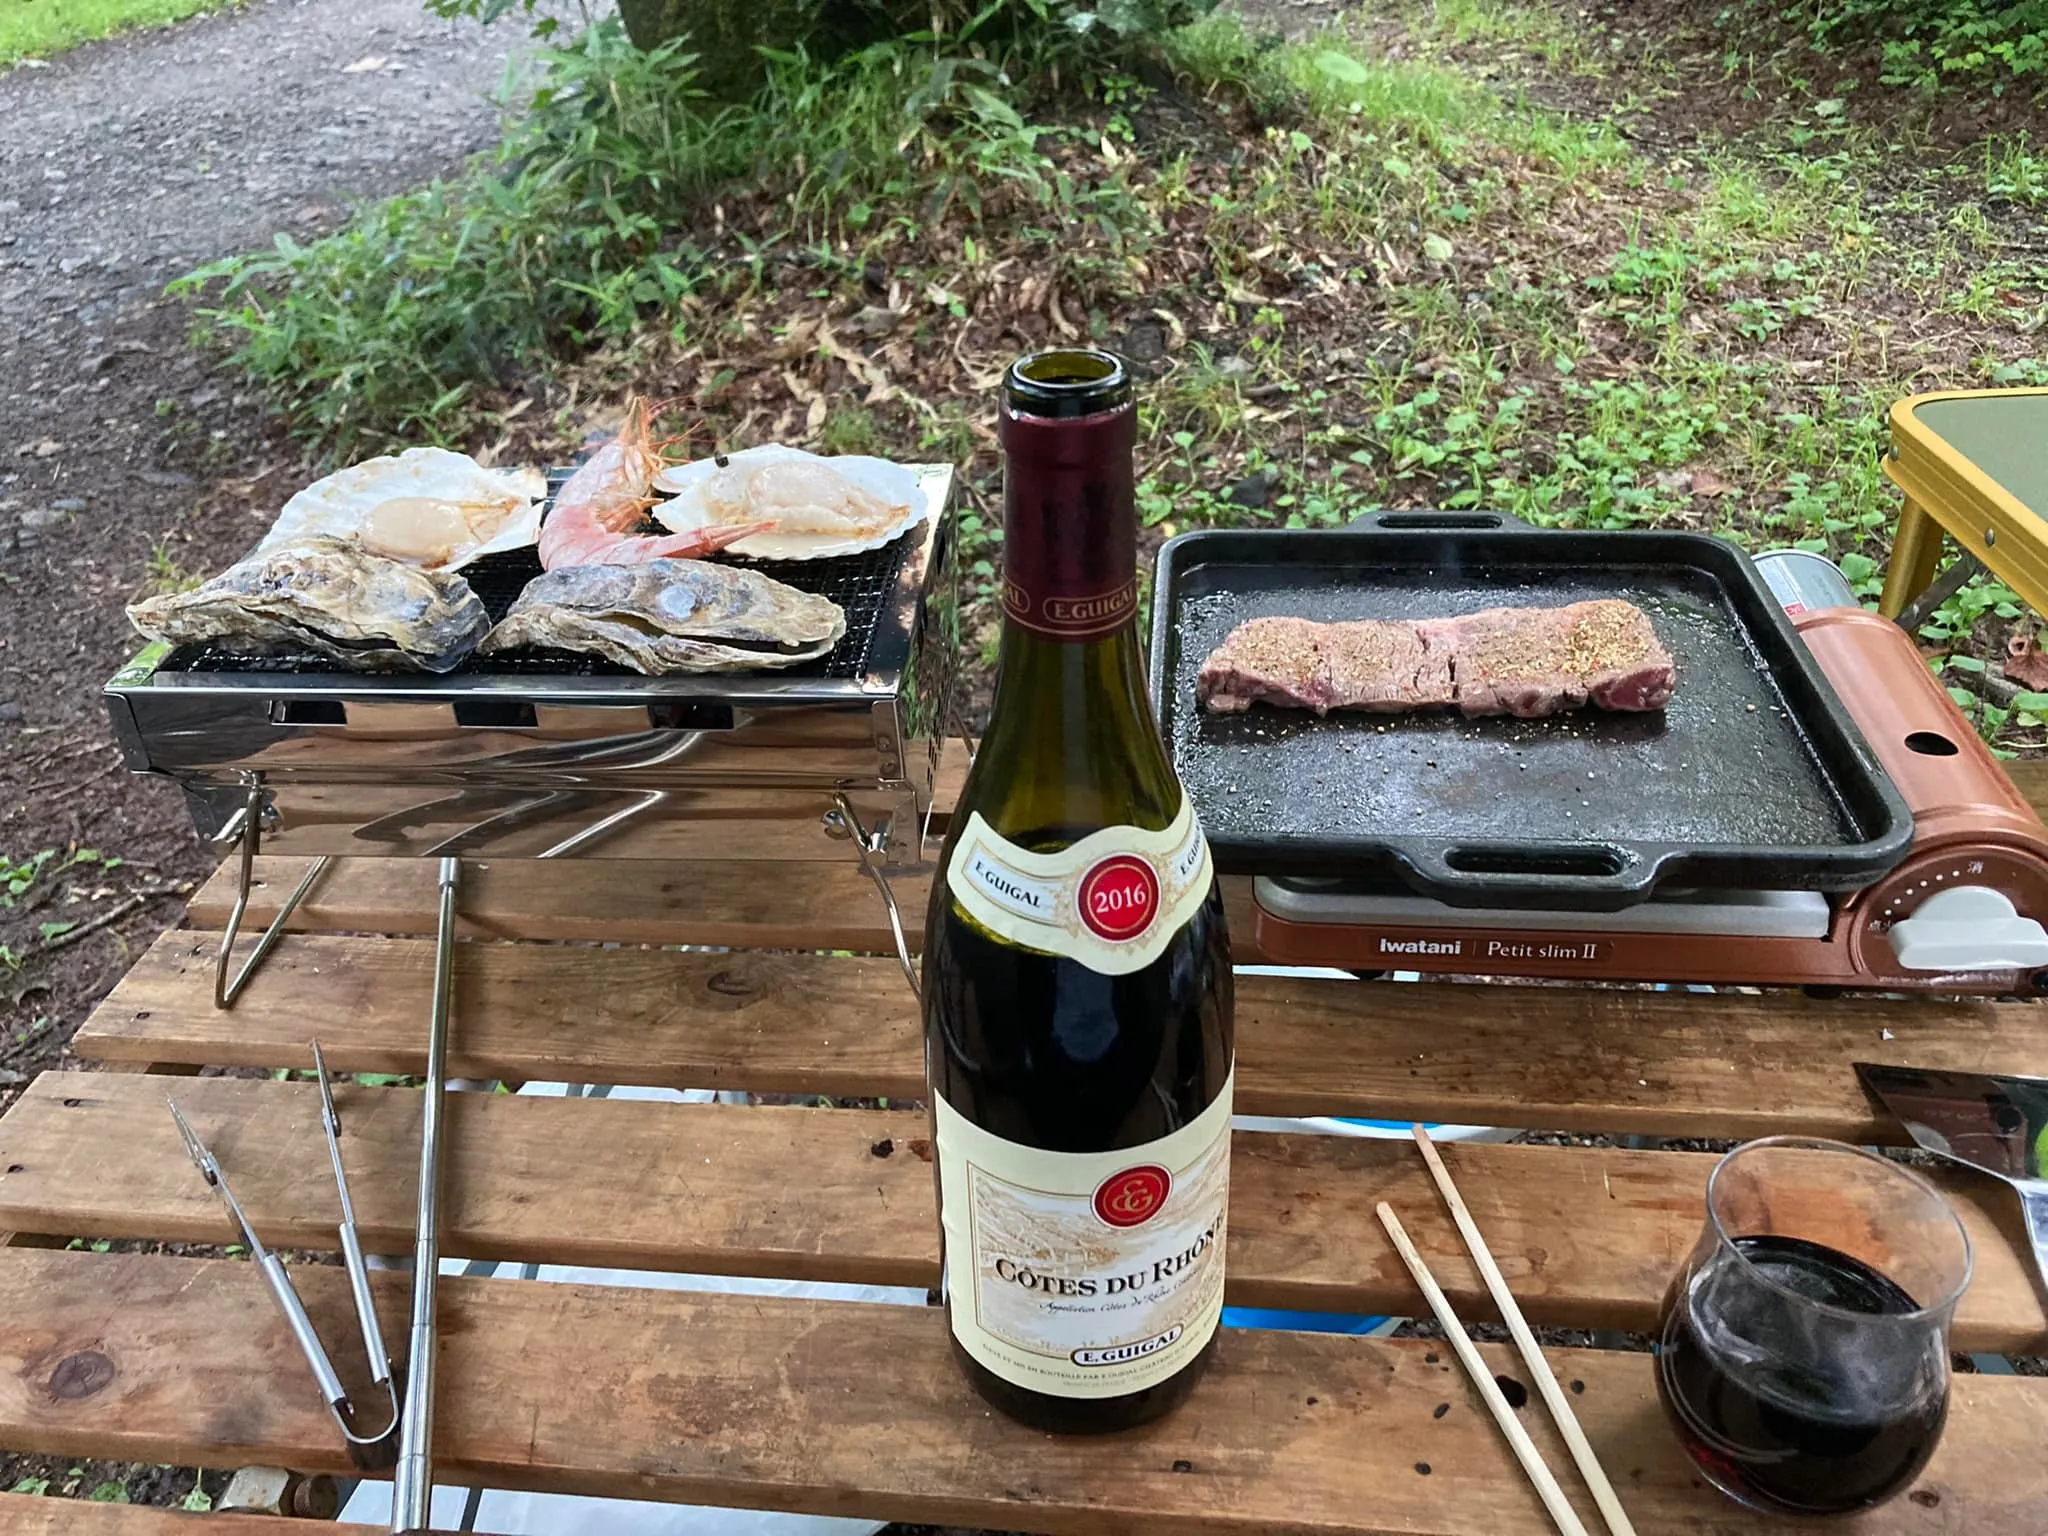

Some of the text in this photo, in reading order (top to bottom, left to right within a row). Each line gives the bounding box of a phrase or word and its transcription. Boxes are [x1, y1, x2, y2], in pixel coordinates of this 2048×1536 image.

[1094, 884, 1147, 914] 2016
[1380, 938, 1461, 955] Iwatani
[1488, 941, 1532, 957] Petit
[1539, 944, 1577, 959] slim
[1105, 1271, 1147, 1295] DU
